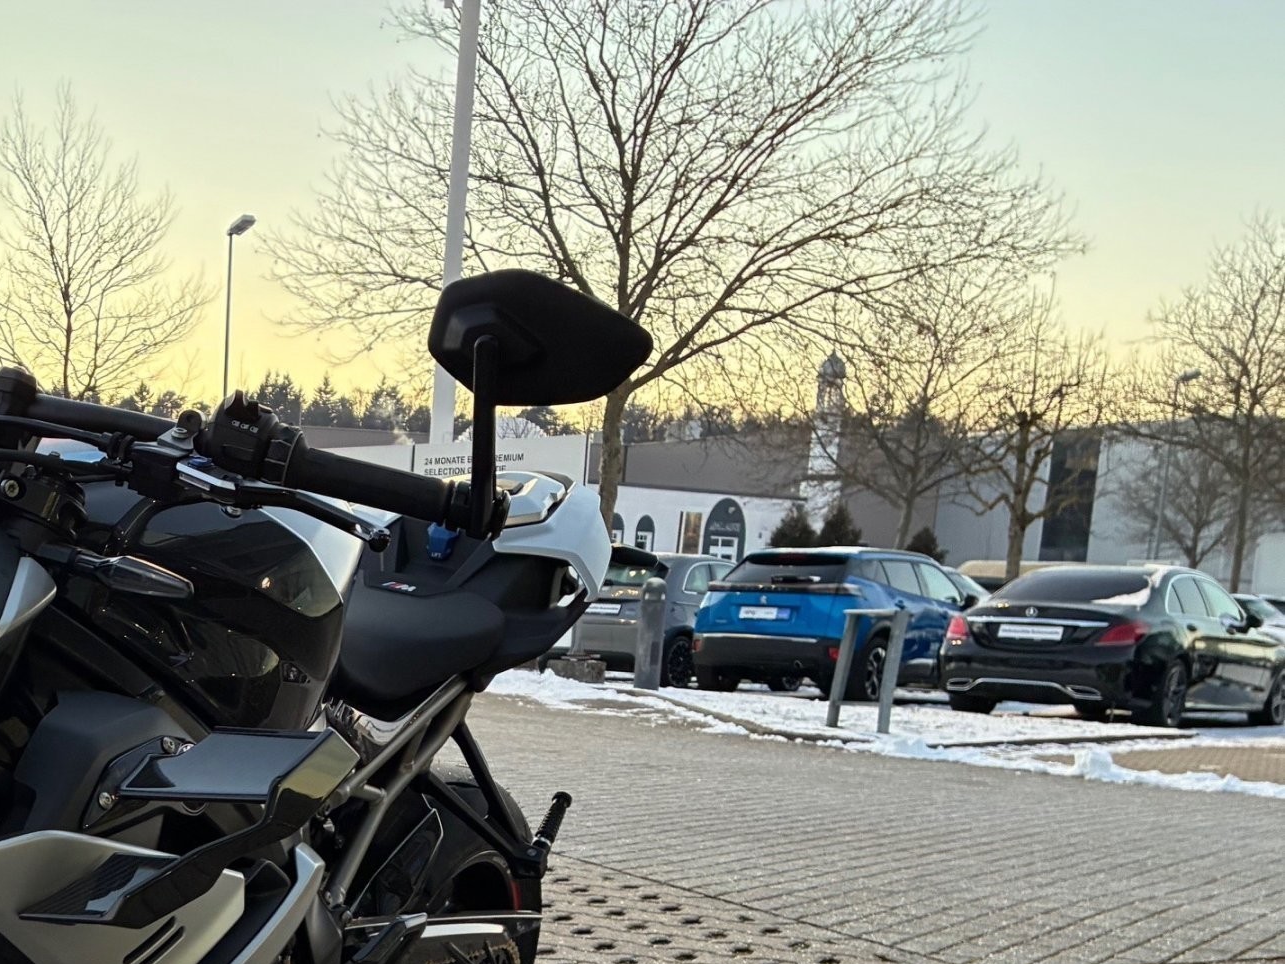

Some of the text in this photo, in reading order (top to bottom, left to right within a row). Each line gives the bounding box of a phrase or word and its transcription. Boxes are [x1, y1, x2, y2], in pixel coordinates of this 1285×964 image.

[424, 457, 433, 466] 24
[434, 455, 465, 465] MONATE
[494, 453, 524, 462] REMIUM
[424, 467, 466, 476] SELECTION
